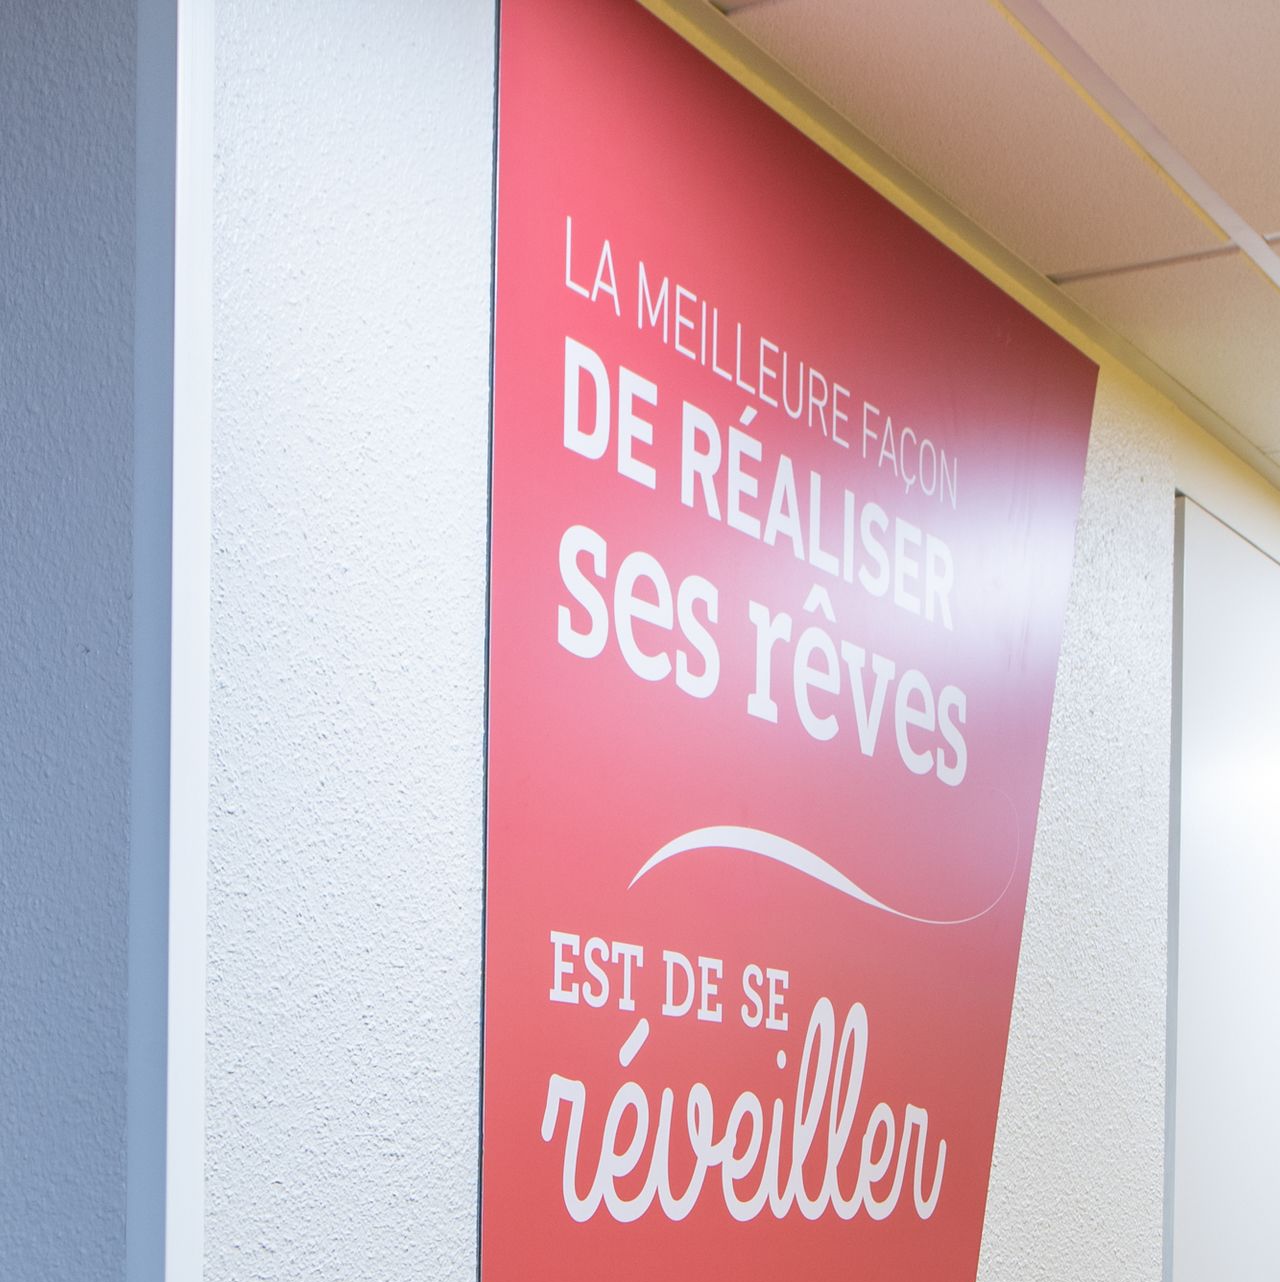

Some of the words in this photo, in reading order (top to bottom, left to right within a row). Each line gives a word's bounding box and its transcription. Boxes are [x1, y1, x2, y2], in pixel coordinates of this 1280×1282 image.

[563, 334, 658, 490] DE
[680, 402, 957, 631] RÉALISER
[565, 214, 621, 317] LA
[637, 260, 851, 449] MEILLEURE
[861, 400, 958, 510] FAÇON
[557, 523, 721, 699] ses
[746, 582, 968, 788] rêves
[540, 996, 948, 1222] réveiller
[549, 929, 644, 1012] EST
[661, 949, 723, 1023] DE
[741, 963, 790, 1032] SE
